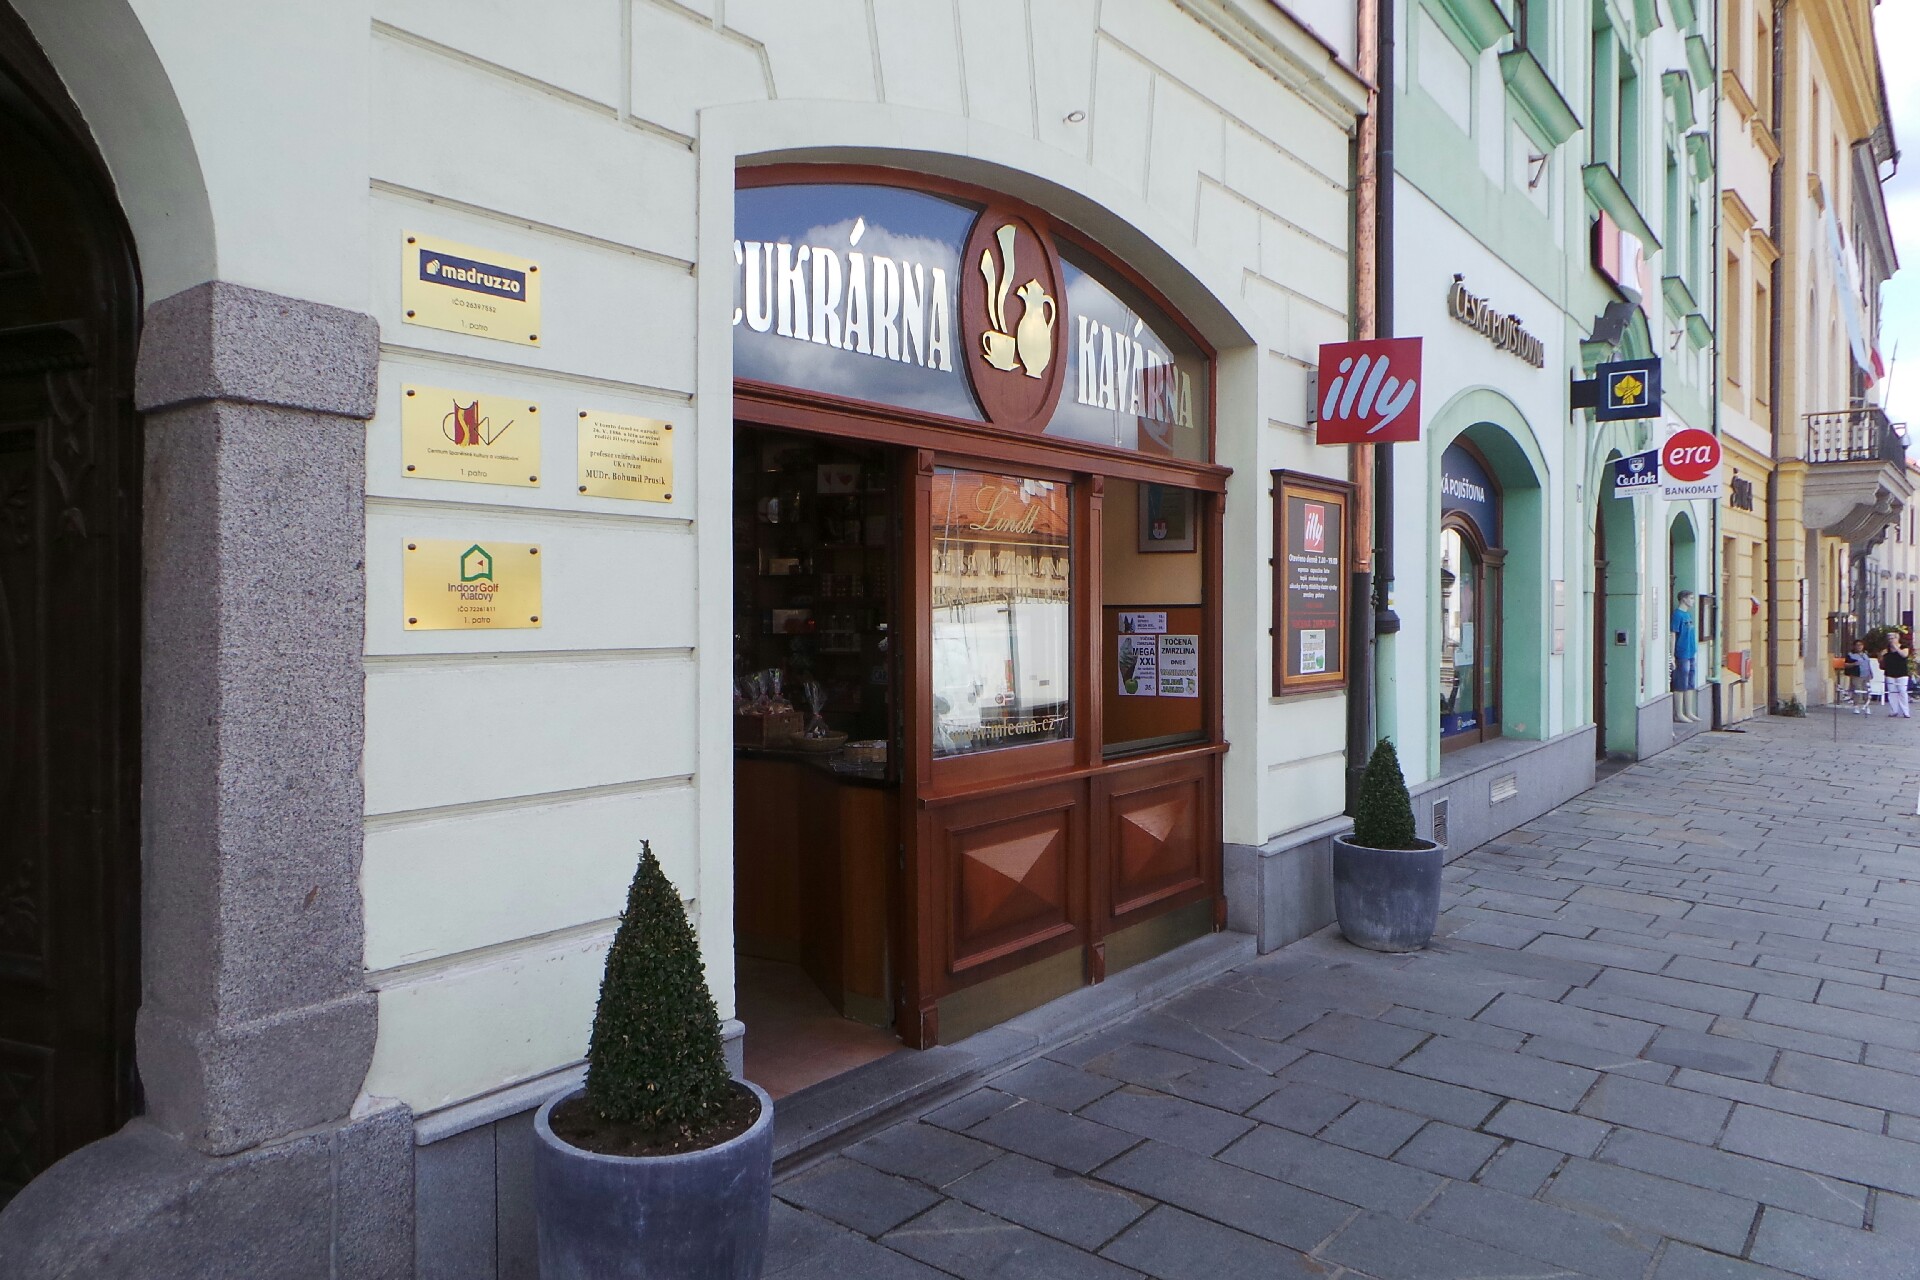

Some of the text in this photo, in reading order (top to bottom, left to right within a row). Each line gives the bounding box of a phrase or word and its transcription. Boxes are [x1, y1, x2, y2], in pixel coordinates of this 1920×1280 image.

[441, 264, 521, 293] madruzzo
[452, 298, 465, 307] IČO
[1447, 273, 1491, 338] ČESKÁ
[469, 322, 488, 332] patro
[1078, 314, 1194, 429] KAVÁRNA
[1322, 353, 1417, 434] illy
[1669, 445, 1711, 466] era
[468, 468, 487, 477] patro
[586, 469, 611, 479] MUDr.
[612, 472, 642, 483] Bohumil
[1665, 484, 1718, 496] BANKOMAT
[969, 485, 1041, 534] Lindt
[1306, 512, 1323, 547] illy
[447, 582, 499, 593] IndoorGolf
[460, 592, 494, 602] Klatovy
[471, 616, 491, 624] patro
[1164, 637, 1193, 646] TOČENÁ
[1132, 647, 1155, 656] MEGA
[1161, 647, 1196, 655] ZMRZLINA
[1139, 657, 1155, 666] XXL
